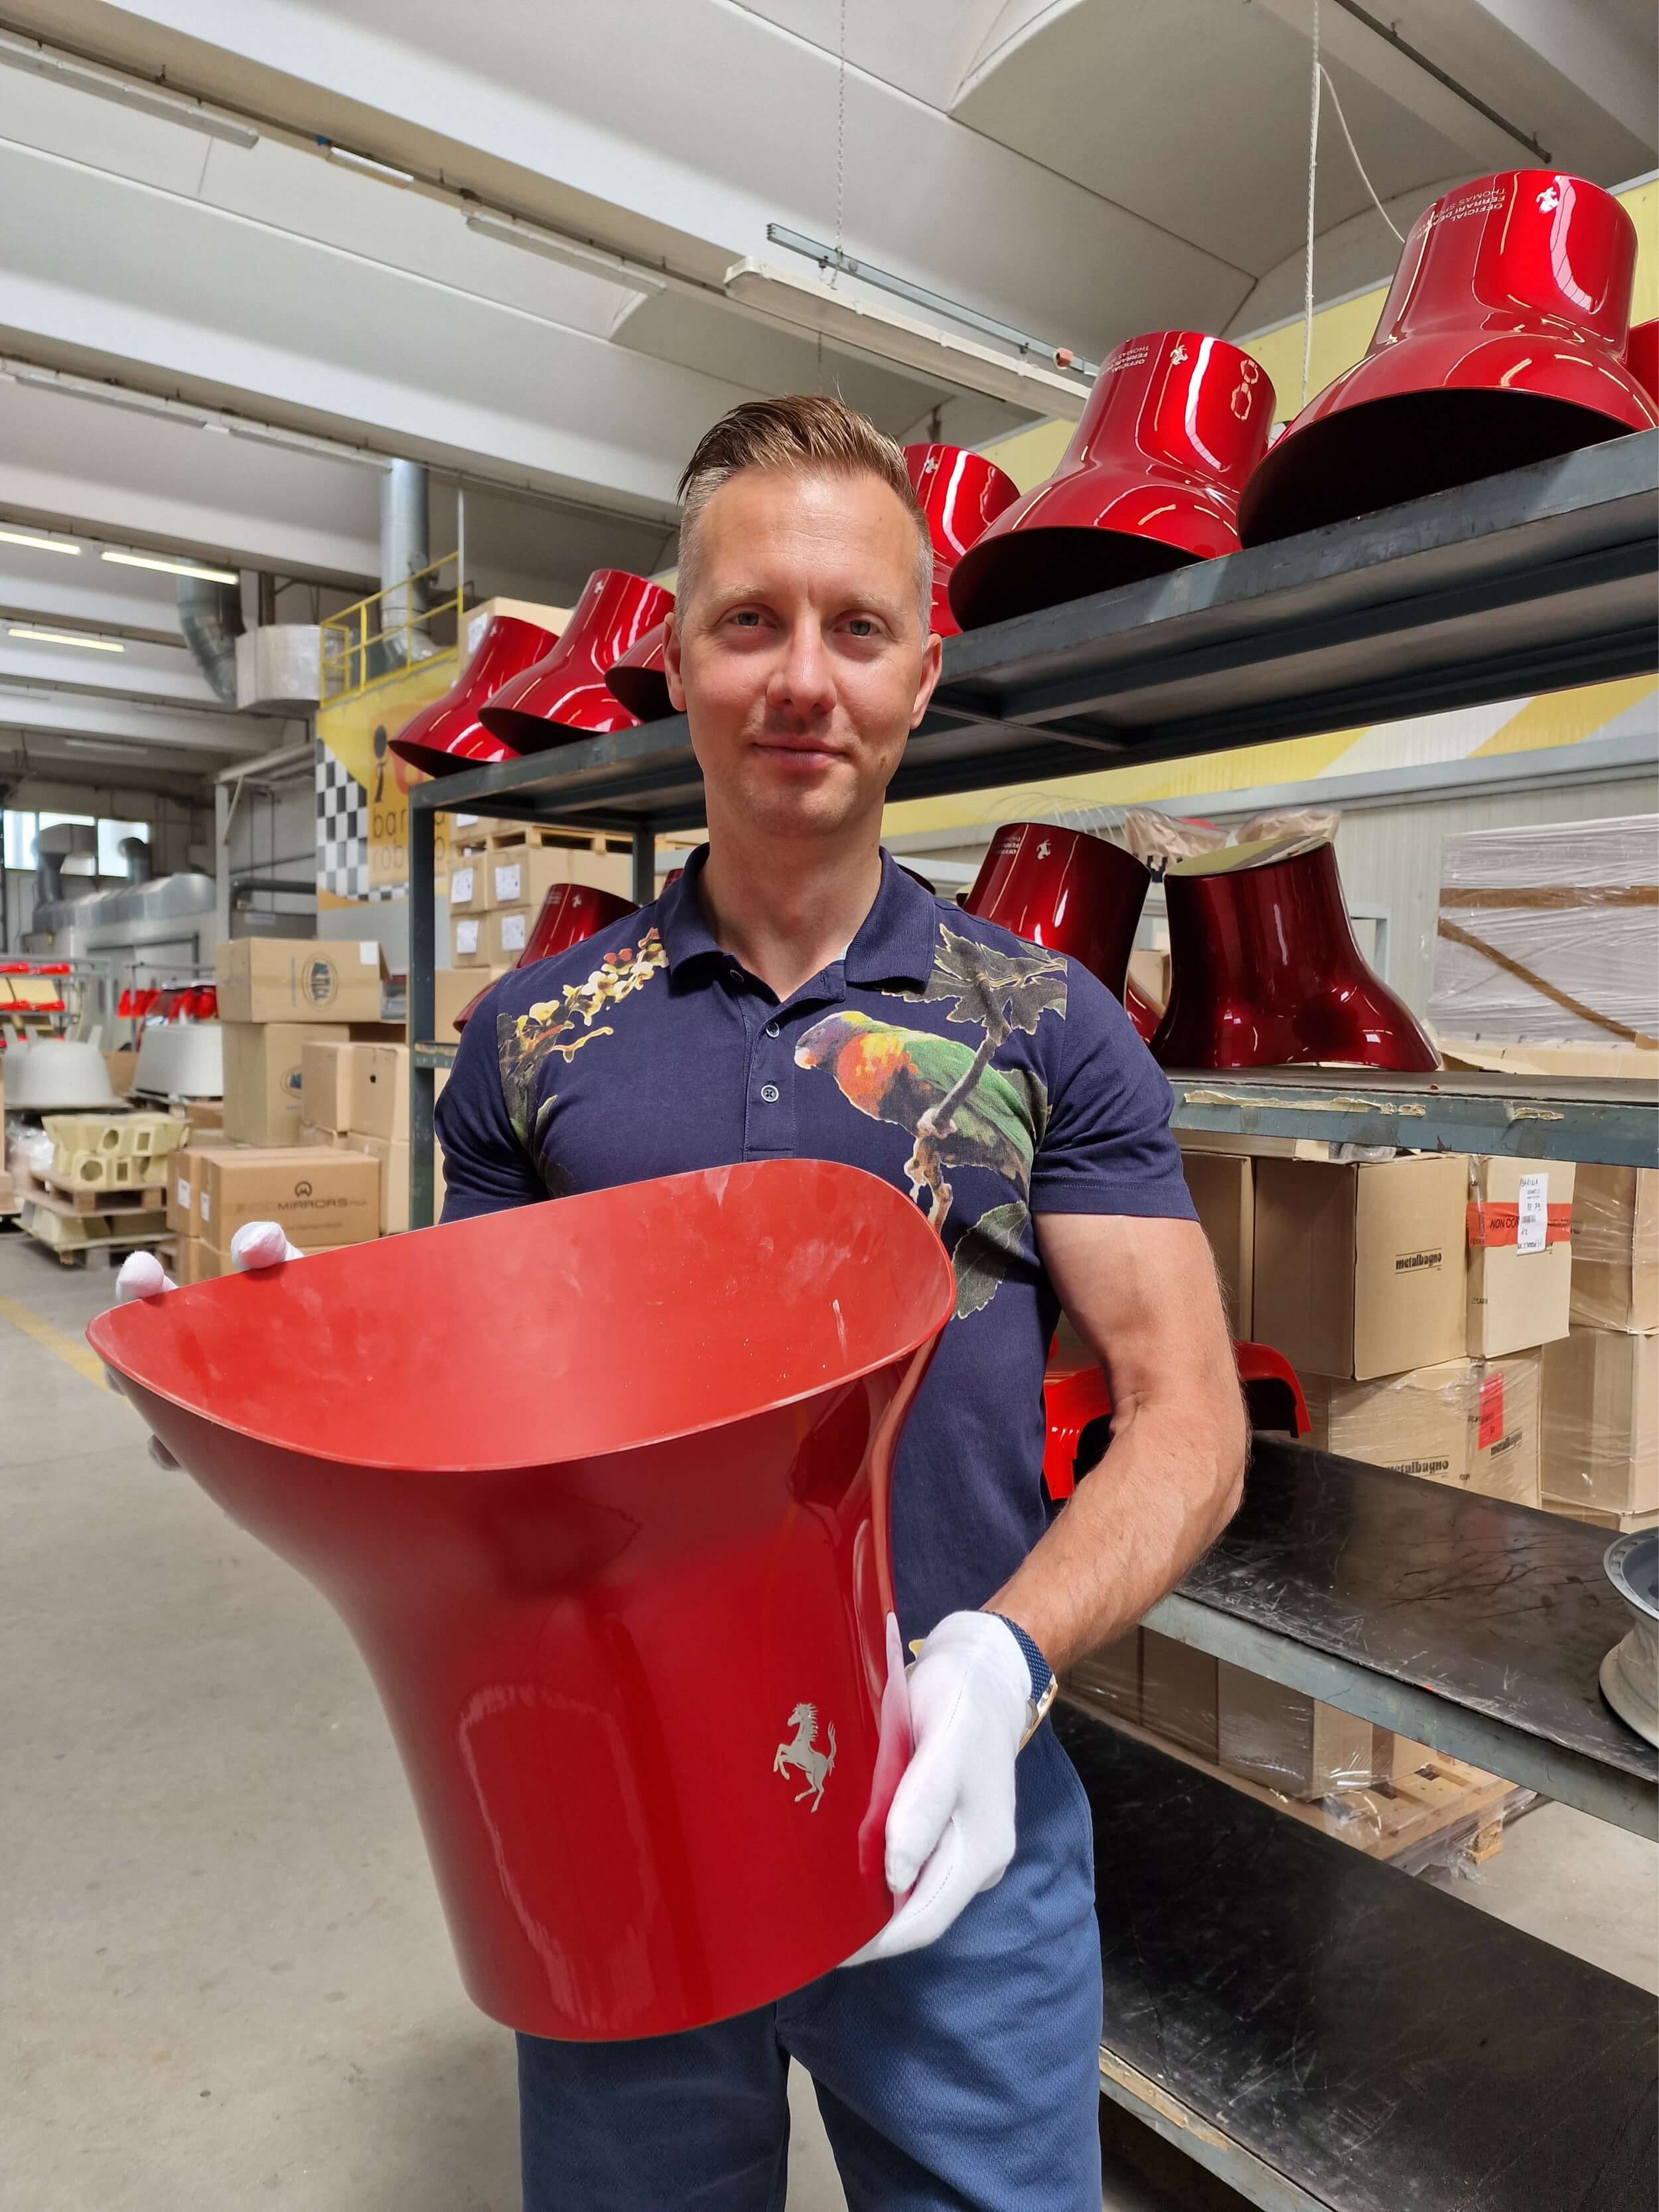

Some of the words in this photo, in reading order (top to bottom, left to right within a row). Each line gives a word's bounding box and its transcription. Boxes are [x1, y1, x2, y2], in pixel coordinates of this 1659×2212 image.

[1455, 195, 1506, 214] FERRARI
[1459, 188, 1507, 206] THOMAS
[1450, 203, 1503, 222] OFFICIAL
[277, 1198, 348, 1211] MIRRORS
[1490, 1218, 1505, 1229] NON
[1395, 1252, 1442, 1270] metalbagno
